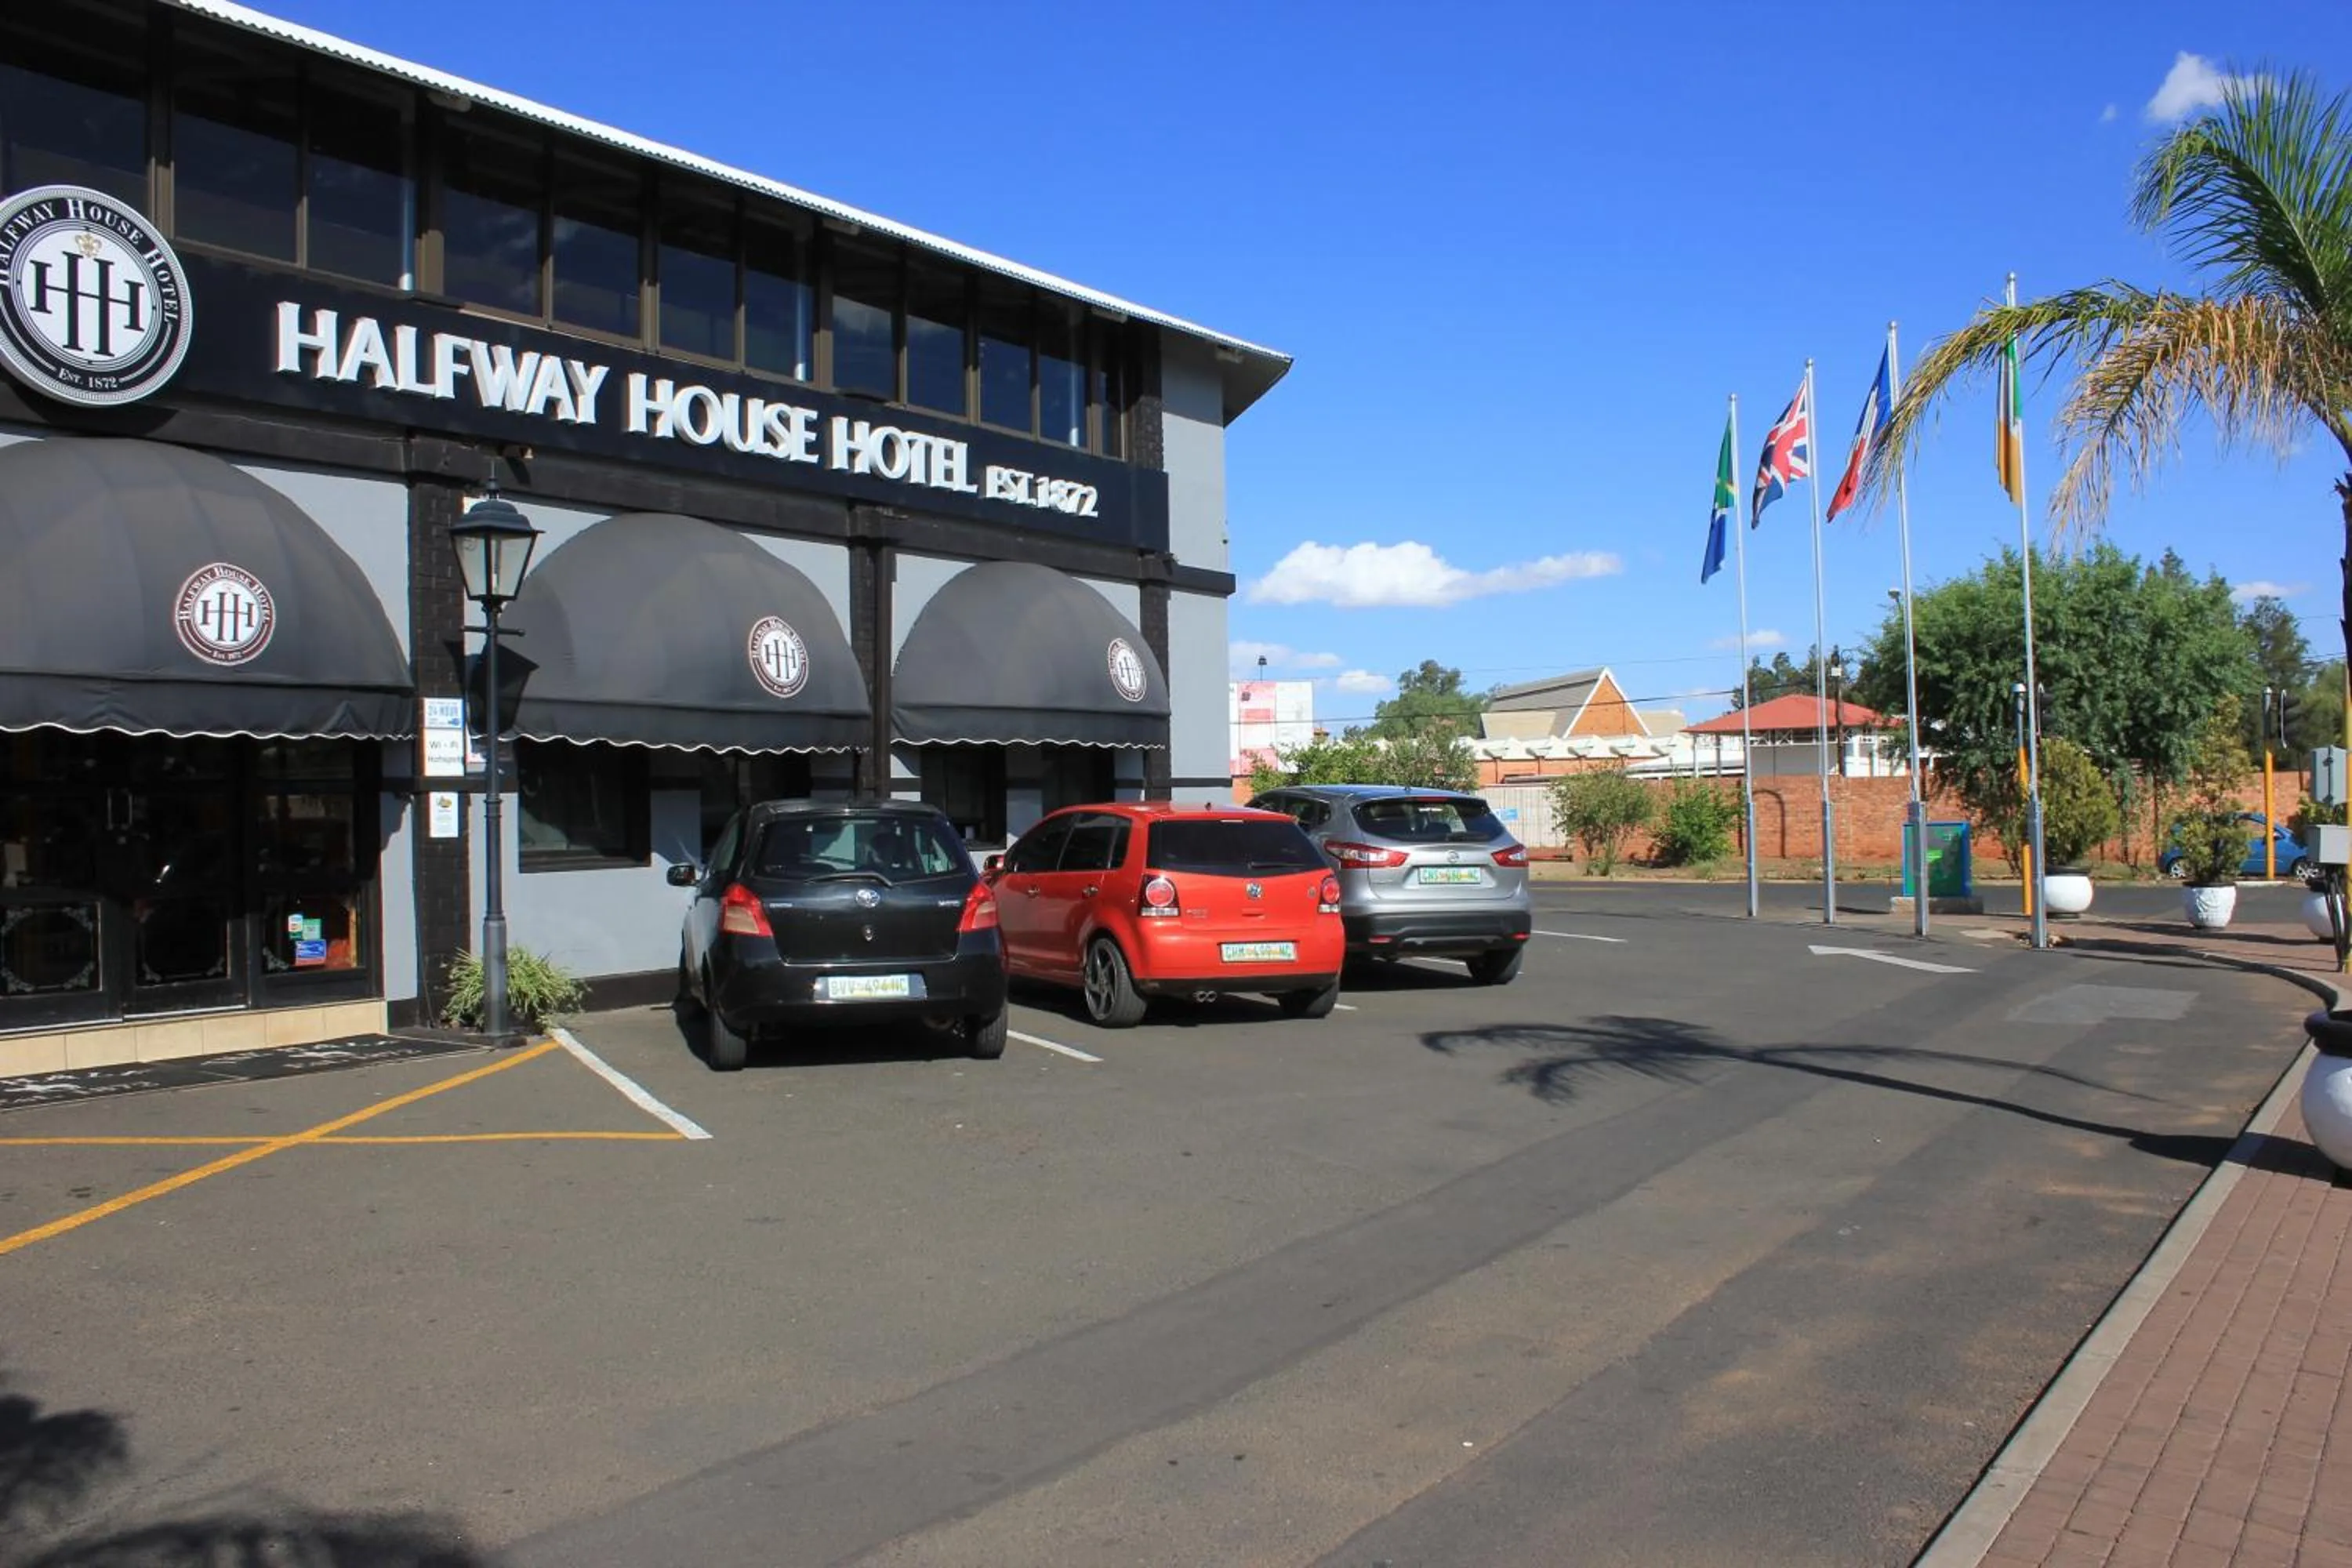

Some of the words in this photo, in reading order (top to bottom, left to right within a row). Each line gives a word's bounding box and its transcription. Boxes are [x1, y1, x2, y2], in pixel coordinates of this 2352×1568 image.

[67, 198, 143, 245] HOUSE
[144, 247, 181, 323] HOTEL
[89, 376, 118, 390] 1872
[276, 300, 609, 424] HALFWAY
[626, 372, 818, 464] HOUSE
[829, 416, 978, 494] HOTEL
